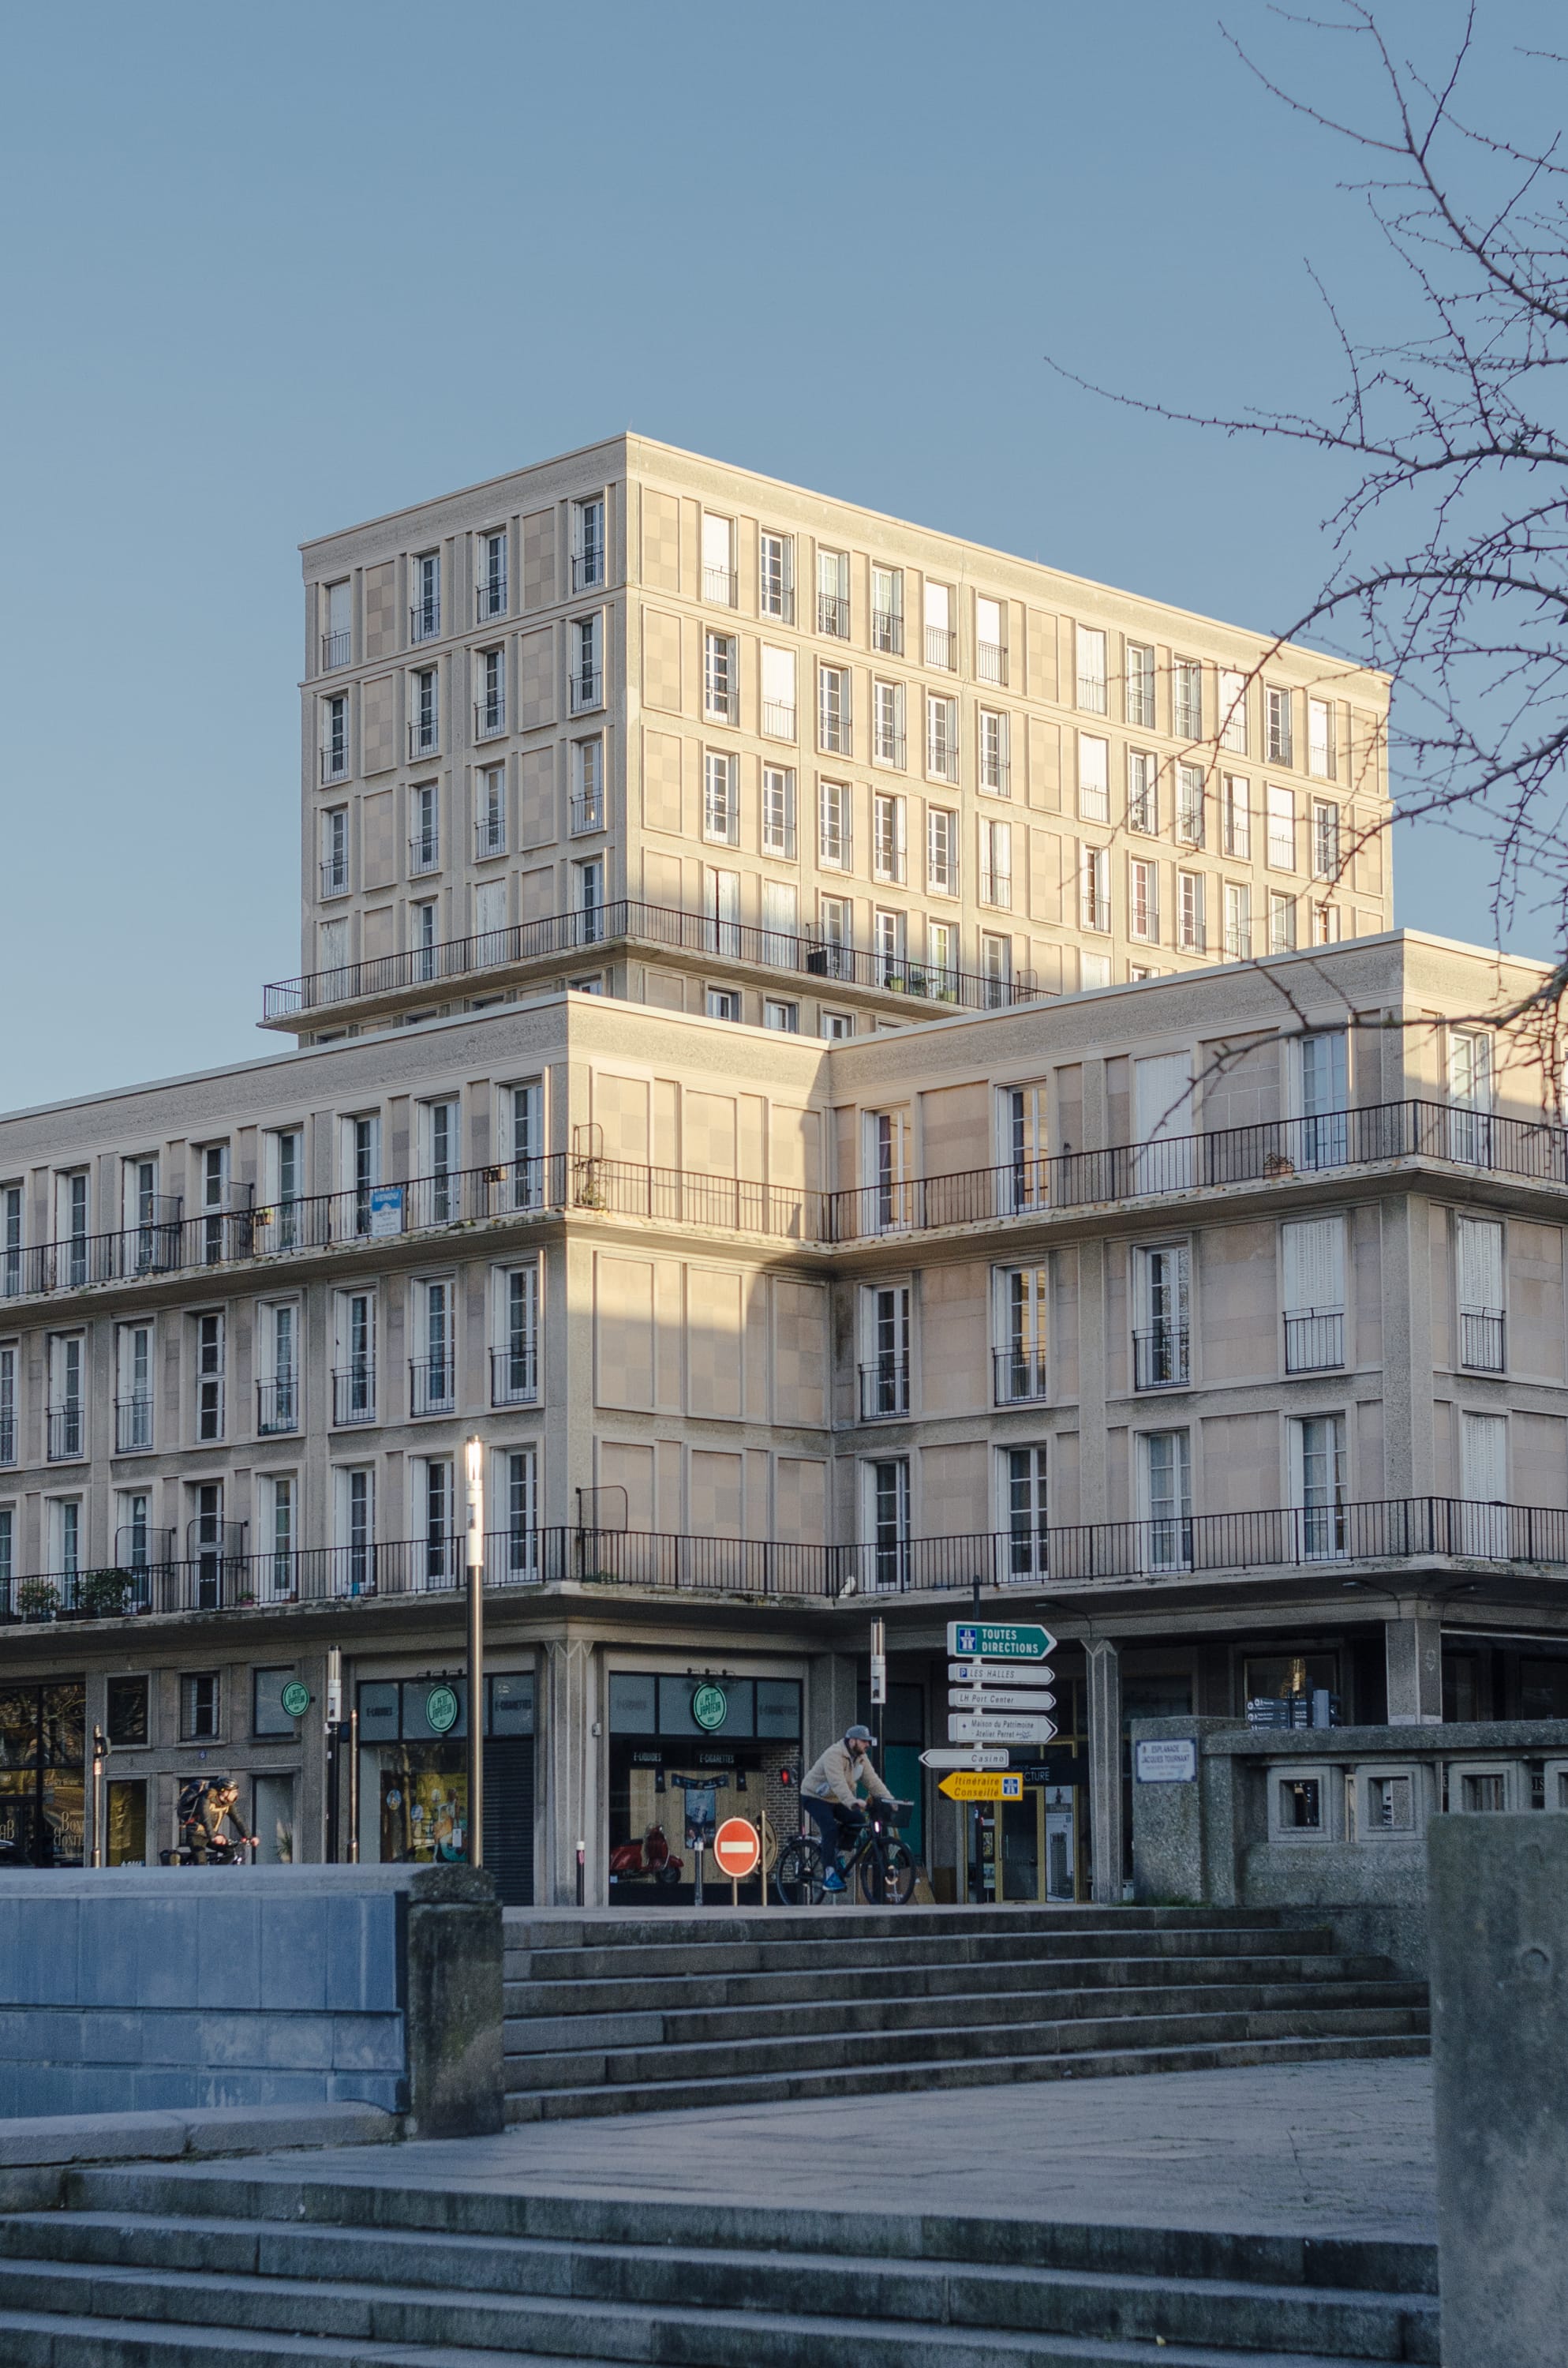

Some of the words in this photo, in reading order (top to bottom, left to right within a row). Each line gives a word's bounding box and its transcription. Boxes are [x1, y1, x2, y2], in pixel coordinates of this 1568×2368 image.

[982, 1628, 1017, 1640] TOUTES
[982, 1641, 1038, 1654] DIRECTIONS
[960, 1668, 967, 1677] P
[970, 1669, 983, 1678] LES
[986, 1669, 1016, 1679] HALLES
[960, 1694, 970, 1703] LH
[971, 1694, 988, 1703] Port
[990, 1695, 1015, 1704] Center
[971, 1719, 992, 1728] Maison
[971, 1754, 1005, 1763] Casino
[955, 1776, 1000, 1785] Itinéraire
[1023, 1770, 1050, 1782] CTURE
[954, 1787, 999, 1797] Conseillé
